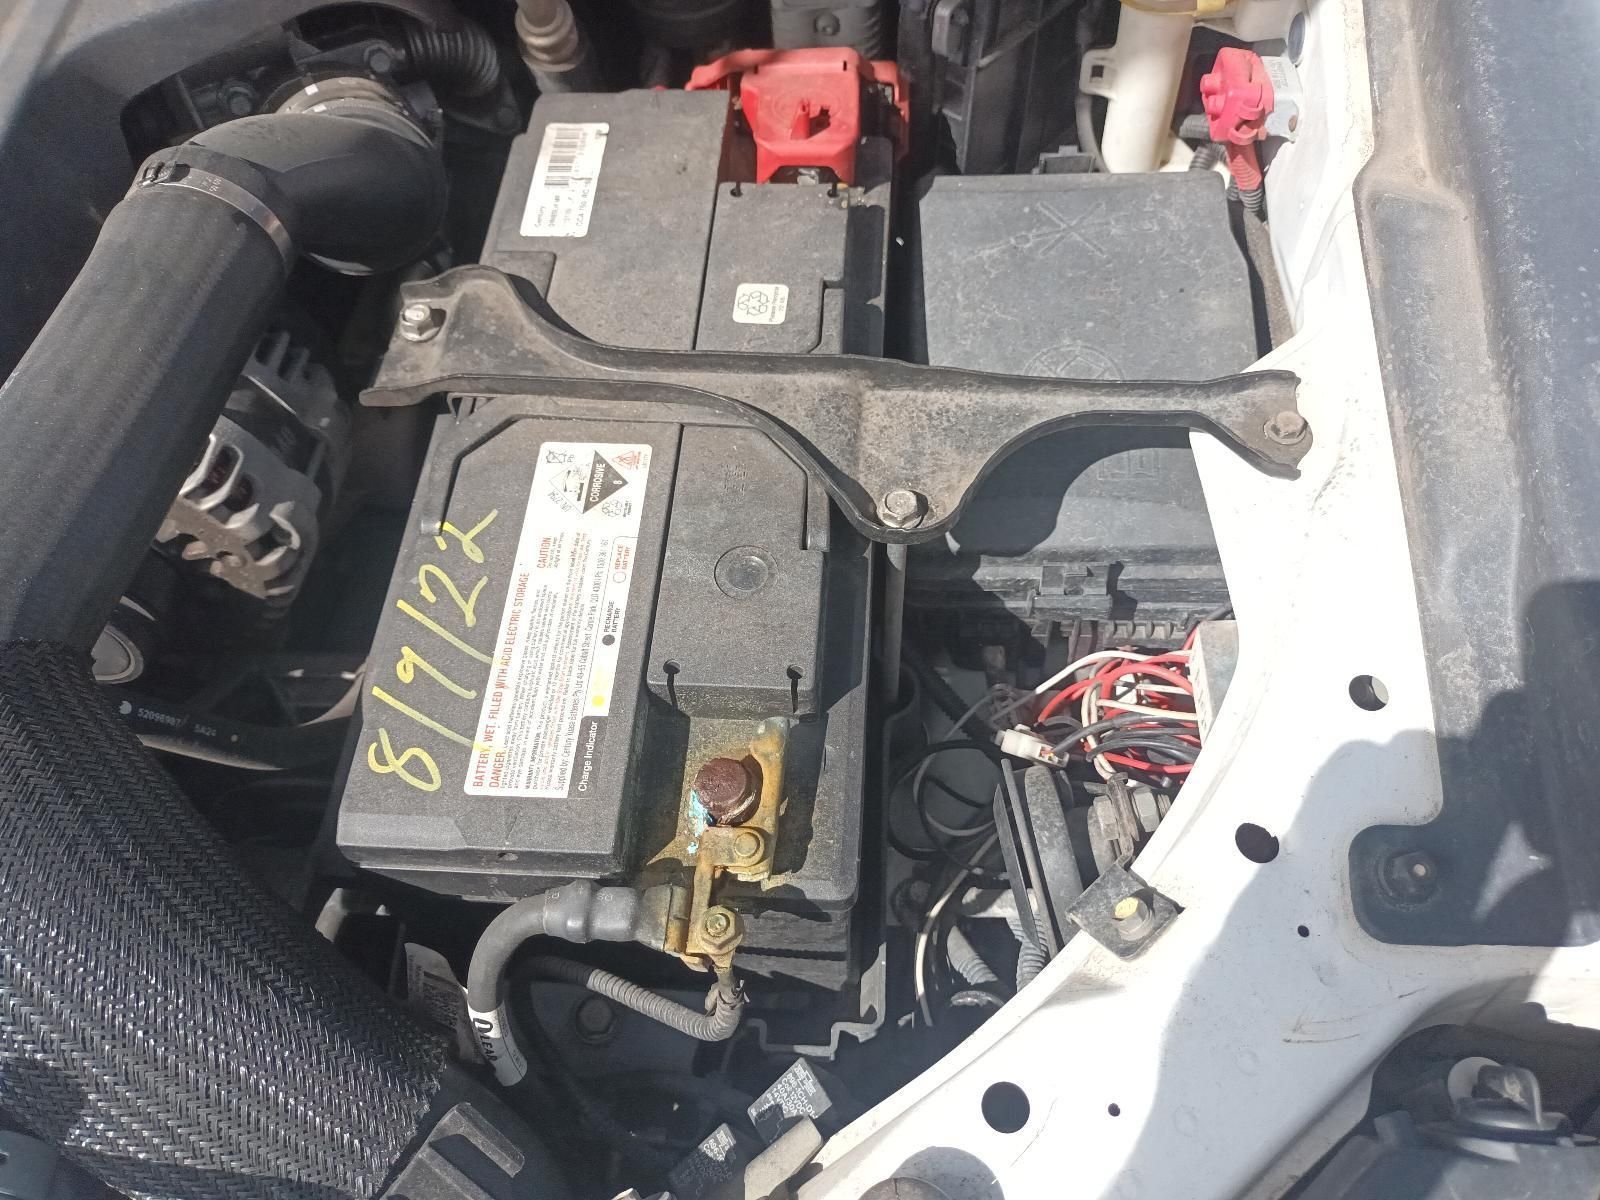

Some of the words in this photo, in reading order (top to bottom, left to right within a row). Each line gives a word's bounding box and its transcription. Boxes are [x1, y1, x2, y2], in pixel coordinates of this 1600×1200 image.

[590, 462, 606, 502] CORROSIVE
[614, 545, 624, 569] REPLACE
[620, 547, 631, 569] BATTERY
[513, 573, 529, 606] STORAGE
[505, 609, 521, 644] ELECTRIC
[603, 601, 615, 632] RECHARGE
[611, 608, 621, 633] BATTERY
[367, 508, 499, 793] 8/9/22
[500, 648, 512, 666] ACID
[495, 669, 508, 688] WITH
[488, 692, 503, 719] FILLED
[565, 721, 575, 736] Yuasa
[584, 721, 600, 758] Indicator
[561, 738, 574, 757] Century
[578, 761, 594, 792] Charge
[480, 1034, 498, 1062] LEAR
[789, 1091, 806, 1114] 12VDC
